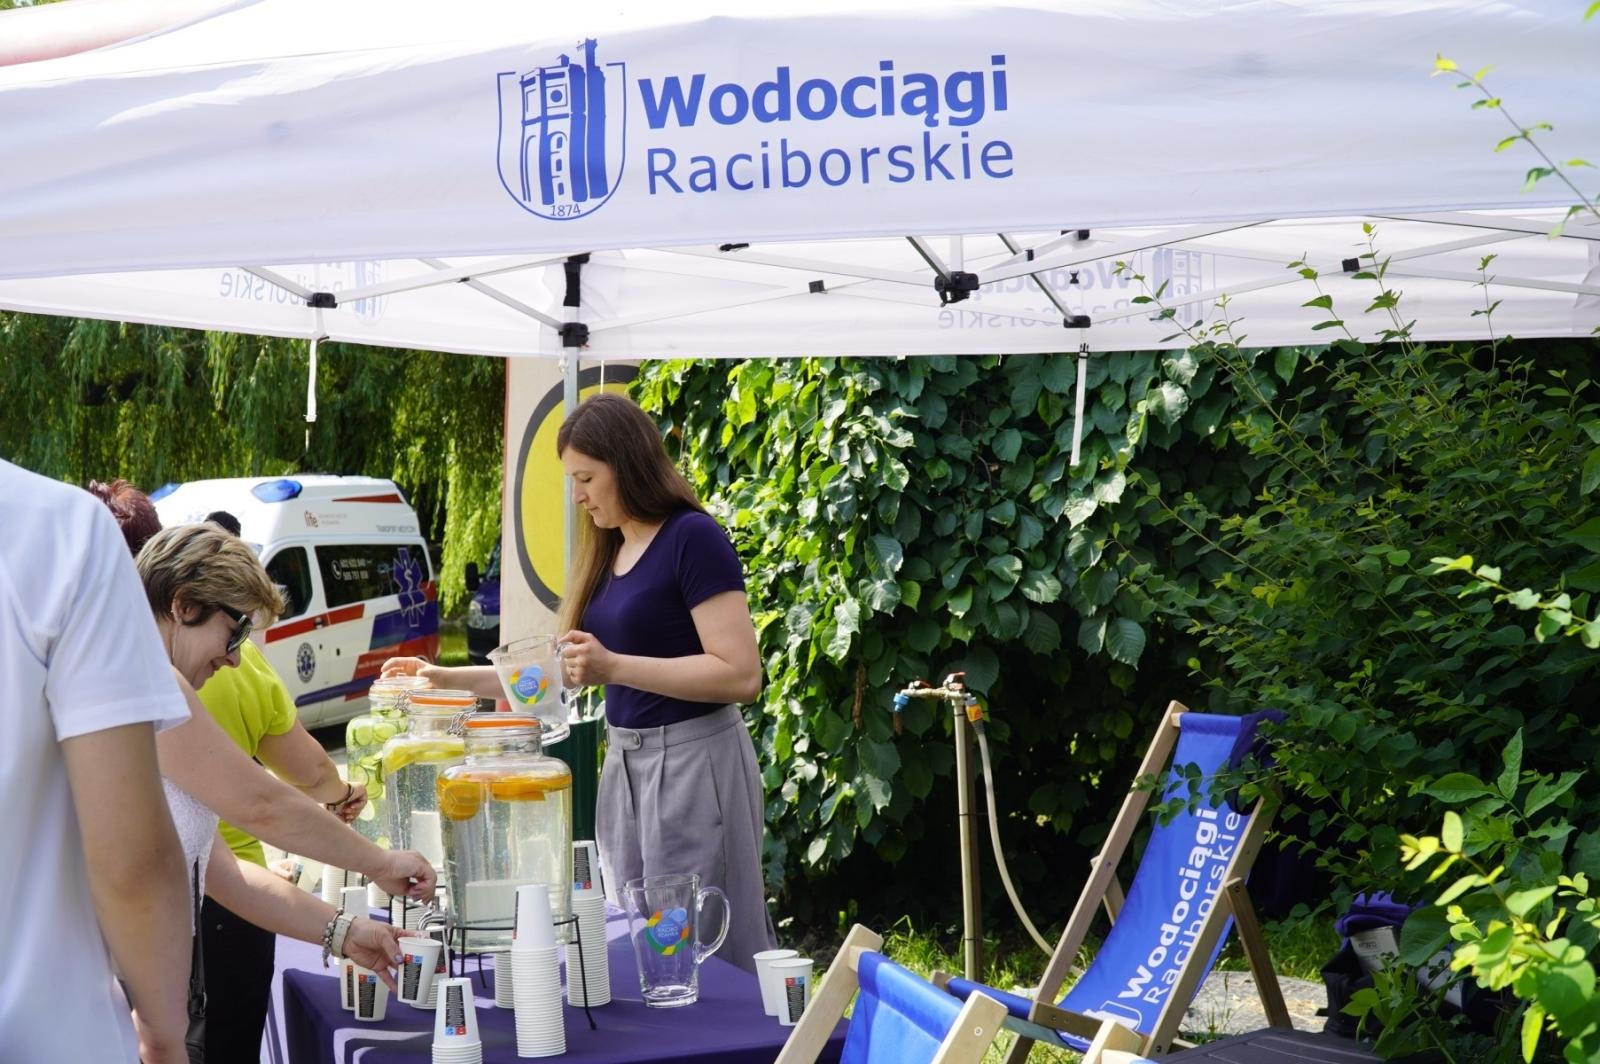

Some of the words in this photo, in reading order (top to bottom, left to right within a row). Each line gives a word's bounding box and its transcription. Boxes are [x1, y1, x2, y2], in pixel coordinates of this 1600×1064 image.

[638, 54, 1008, 130] Wodociągi
[646, 130, 1014, 194] Raciborskie
[550, 203, 582, 217] 1874
[1117, 808, 1218, 998] Wodociągi
